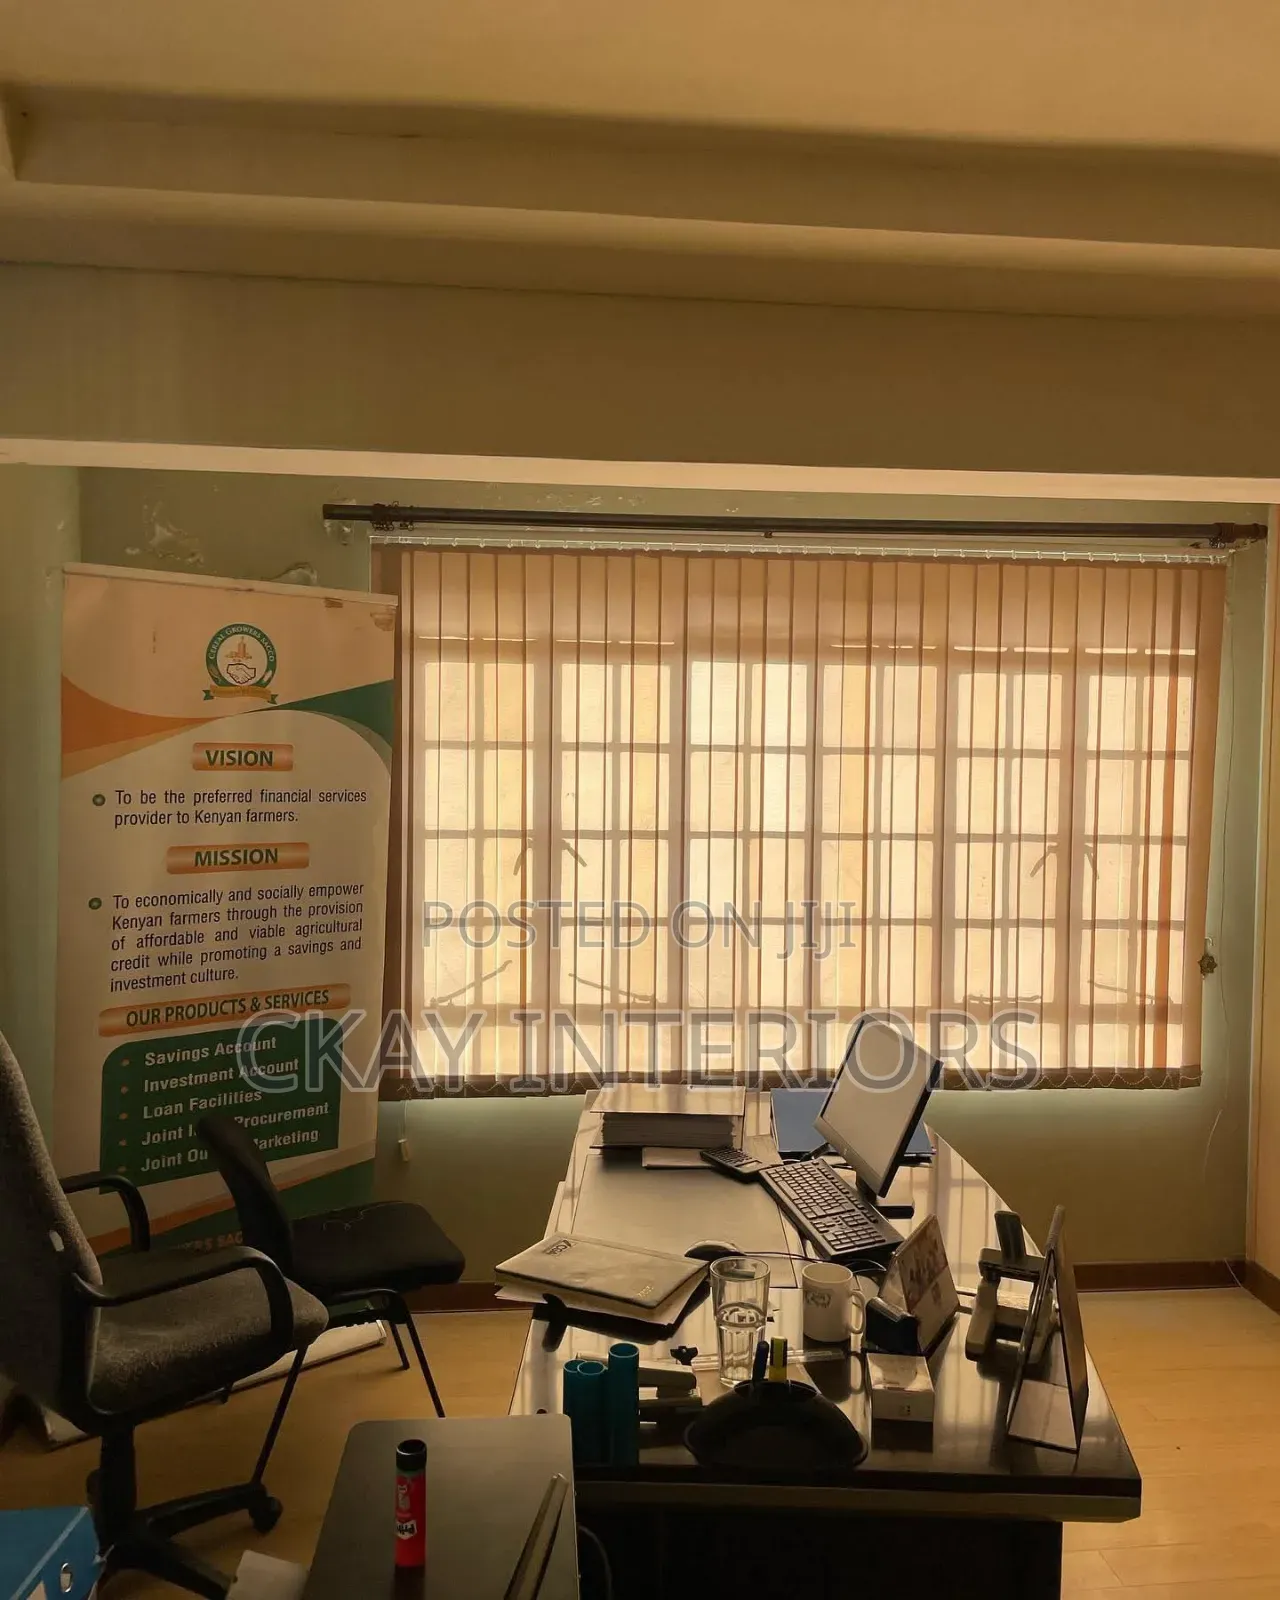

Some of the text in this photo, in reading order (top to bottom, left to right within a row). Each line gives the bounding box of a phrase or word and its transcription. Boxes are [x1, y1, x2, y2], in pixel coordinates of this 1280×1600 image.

[205, 750, 273, 767] VISION
[115, 789, 367, 807] To be the preferred financial services
[114, 808, 299, 829] provider to Kenyan farmers.
[194, 848, 279, 867] MISSION
[113, 884, 365, 910] To economically and socially empower
[112, 901, 364, 932] Kenyan farmers through the provision
[111, 918, 363, 951] of affordable and viable agricultural
[111, 937, 362, 972] credit while promoting a savings and
[110, 967, 239, 993] investment culture.
[126, 989, 330, 1027] OUR PRODUCTS & SERVICES
[144, 1036, 277, 1068] Savings Account
[144, 1058, 300, 1093] Investment Account
[143, 1090, 263, 1119] Loan Facilities
[141, 1125, 183, 1147] Joint
[141, 1151, 183, 1173] Joint
